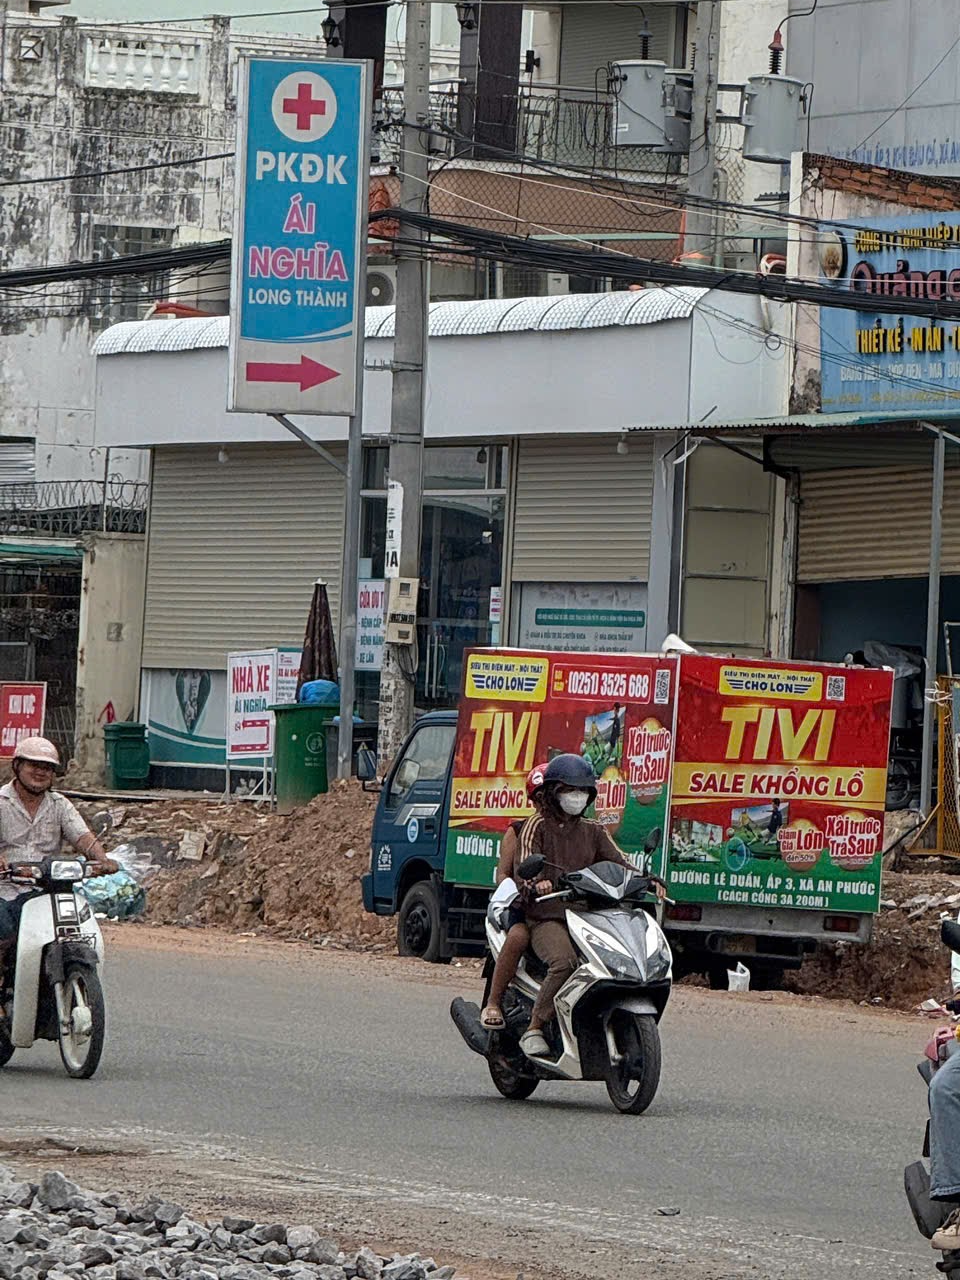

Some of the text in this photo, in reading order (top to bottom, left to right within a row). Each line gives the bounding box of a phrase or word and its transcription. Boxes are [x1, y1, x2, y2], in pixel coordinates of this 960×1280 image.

[254, 150, 348, 186] PKĐK
[283, 192, 316, 234] ÁI
[248, 243, 349, 282] NGHĨA
[248, 285, 348, 308] LONG THÀNH
[855, 318, 886, 354] THIẾT
[886, 317, 905, 354] KẾ
[911, 326, 926, 353] IN
[925, 318, 945, 352] ẤN
[232, 659, 254, 694] NHÀ
[256, 664, 270, 693] XE
[568, 670, 599, 696] (0251)
[600, 672, 627, 697] 3525
[628, 673, 649, 698] 688
[234, 696, 267, 713] ÁI NGHĨA
[470, 711, 541, 773] TIVI
[721, 706, 836, 761] TIVI
[643, 754, 666, 784] Sau
[689, 772, 746, 795] SALE
[750, 765, 829, 796] KHỔNG
[454, 782, 524, 810] SALE KHỔNG
[796, 828, 823, 851] Lớn
[826, 815, 880, 837] Xài trước
[456, 833, 493, 856] ĐƯỜNG
[830, 835, 875, 856] Trả Sau
[670, 869, 710, 886] ĐƯỜNG
[714, 871, 727, 886] LÊ
[766, 873, 782, 890] ẤP
[785, 878, 796, 892] 3,
[799, 877, 814, 892] XÃ
[817, 879, 833, 893] AN
[836, 880, 876, 896] PHƯỚC
[751, 887, 778, 905] CỐNG
[780, 894, 793, 905] 3A
